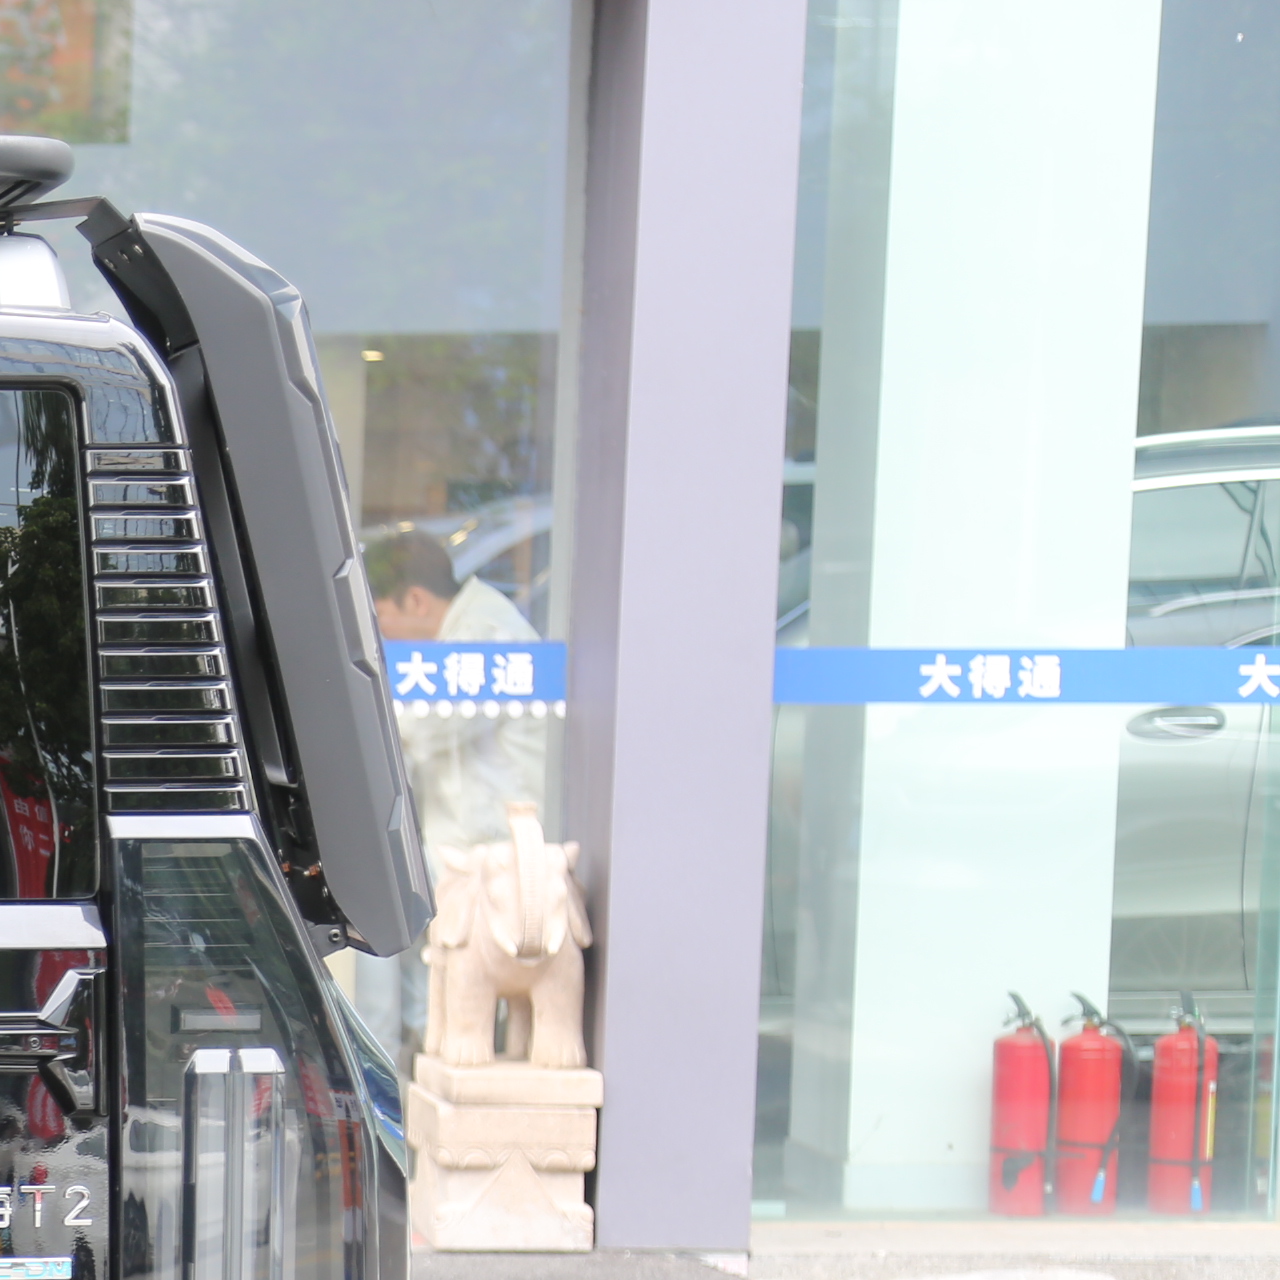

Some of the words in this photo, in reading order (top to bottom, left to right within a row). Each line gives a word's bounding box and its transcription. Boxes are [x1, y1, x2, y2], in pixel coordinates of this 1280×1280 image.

[395, 651, 535, 697] 大得通
[918, 653, 1062, 699] 大得通
